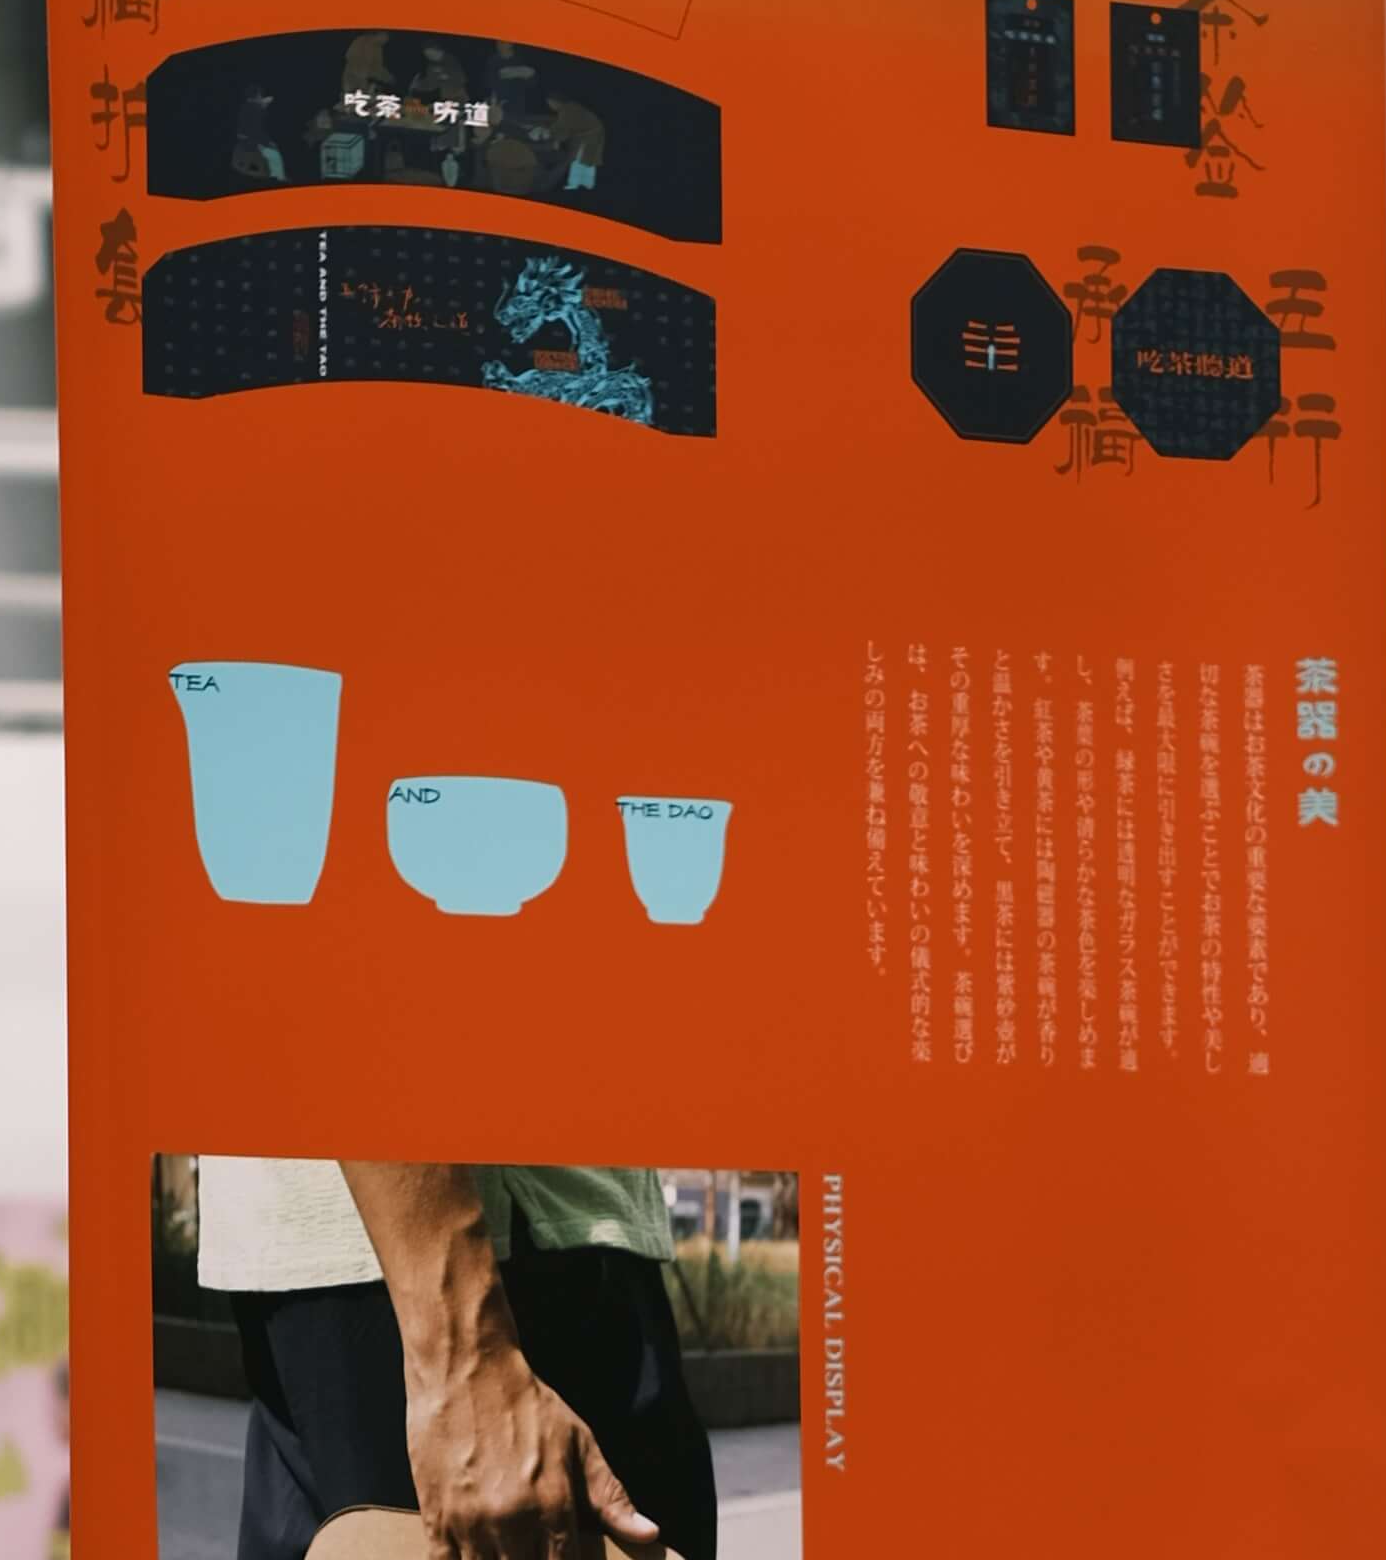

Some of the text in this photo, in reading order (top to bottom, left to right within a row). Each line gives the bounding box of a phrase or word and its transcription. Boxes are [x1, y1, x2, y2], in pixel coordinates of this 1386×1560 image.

[344, 90, 401, 120] 吃茶
[170, 672, 220, 692] TEA
[1295, 657, 1341, 828] 茶器の美
[388, 786, 441, 805] AND
[616, 801, 714, 820] THE DAO
[823, 1173, 846, 1473] PHYSICAL DISPLAY
